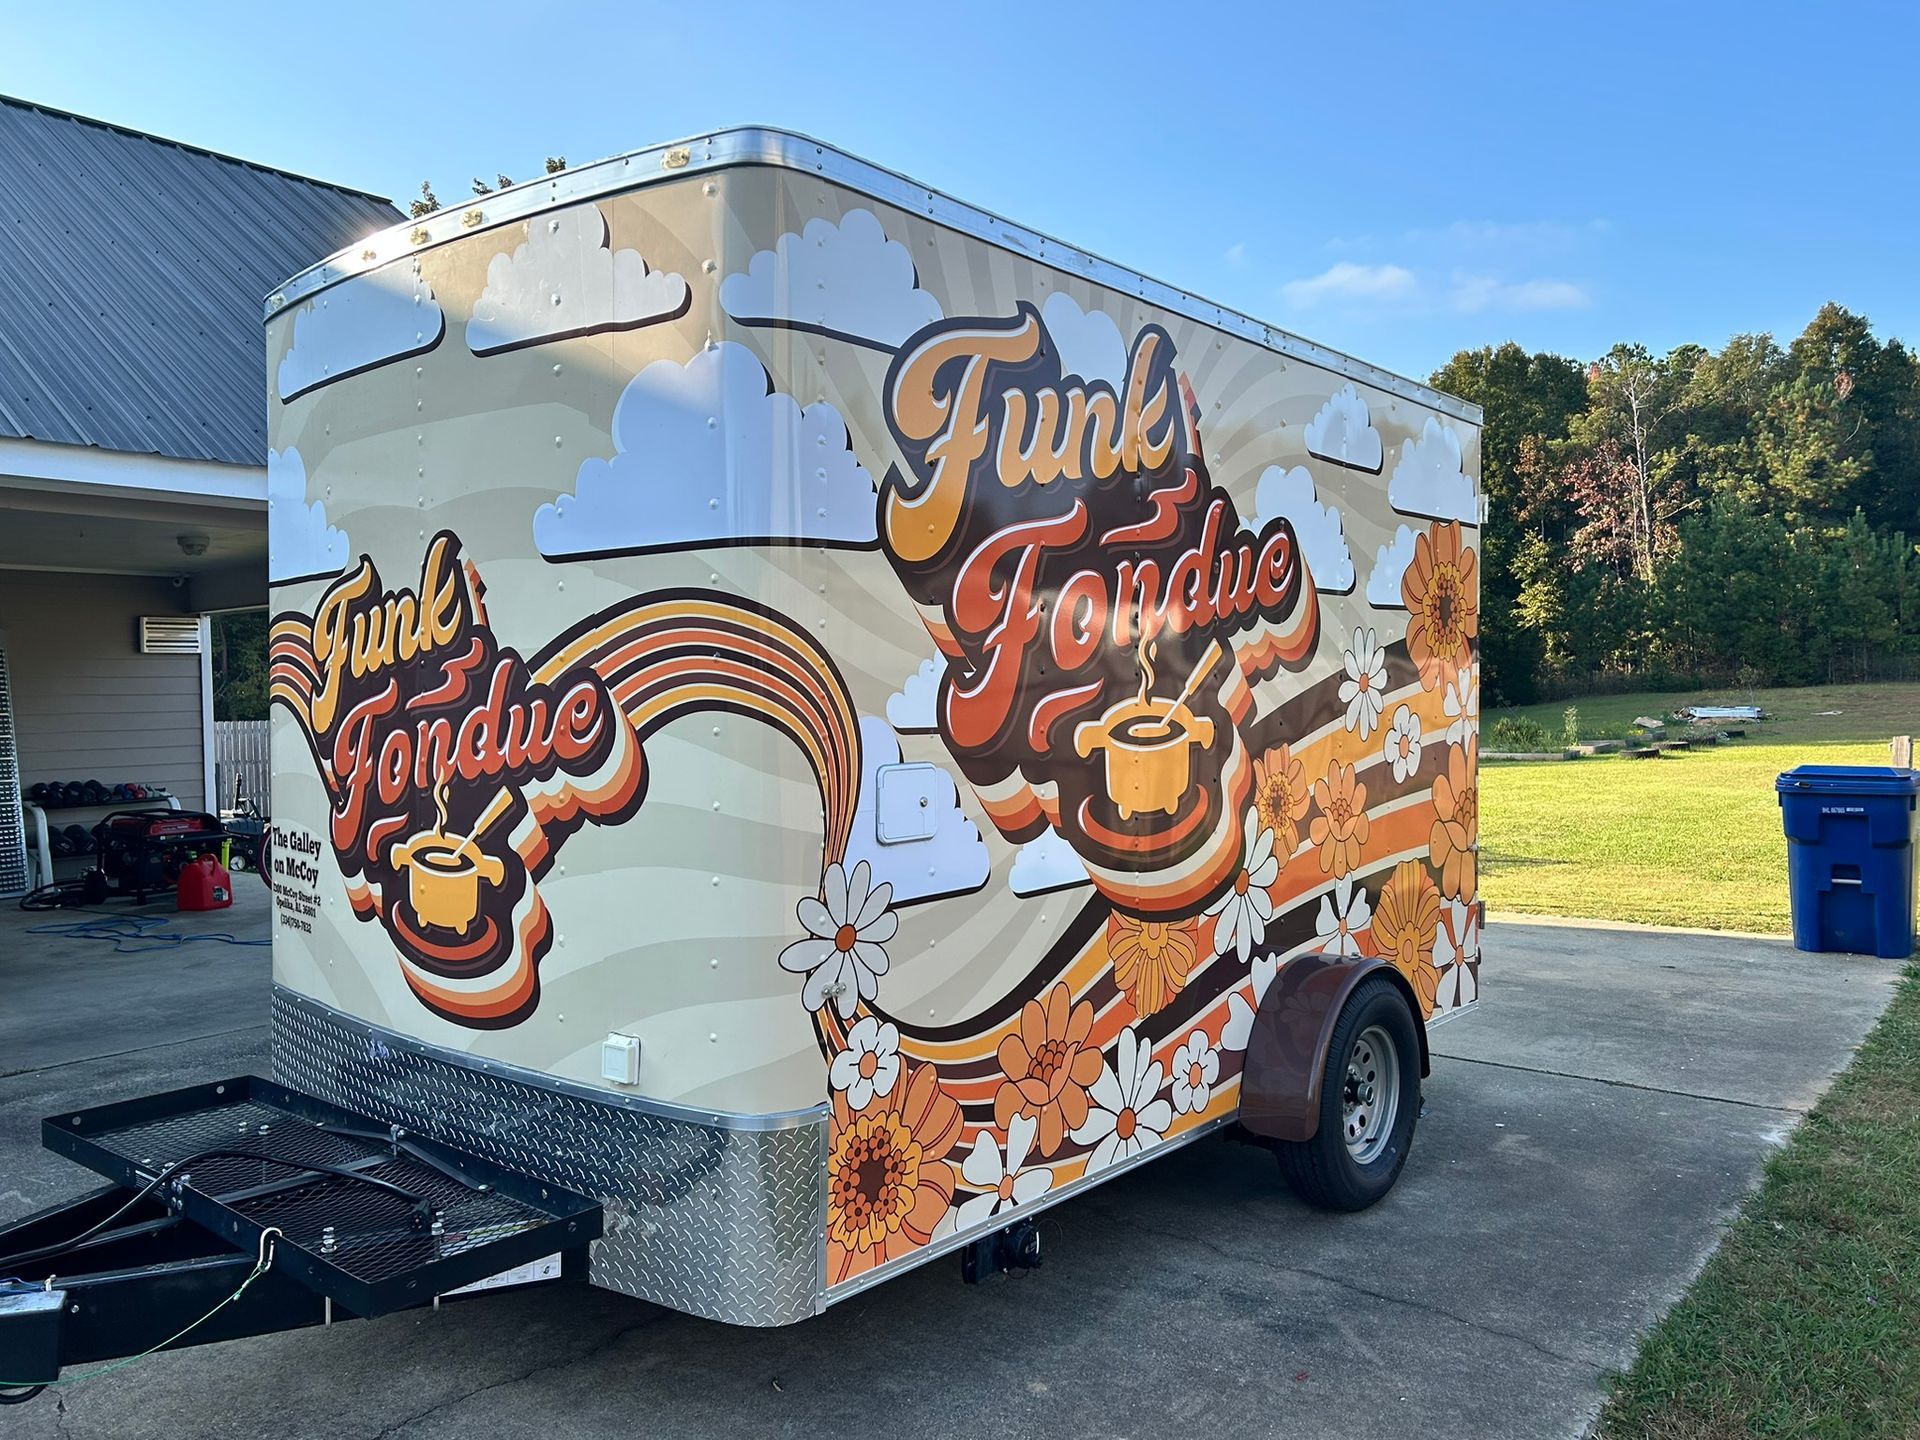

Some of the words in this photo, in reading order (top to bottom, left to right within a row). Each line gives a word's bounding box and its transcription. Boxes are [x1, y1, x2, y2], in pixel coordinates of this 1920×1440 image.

[885, 311, 1175, 562] Funk
[311, 536, 462, 734] Funk
[946, 497, 1294, 748] Fondue
[273, 826, 288, 849] The
[290, 830, 321, 861] Galley
[332, 658, 605, 851] Fondue
[274, 859, 284, 874] on
[286, 857, 318, 889] McCoy
